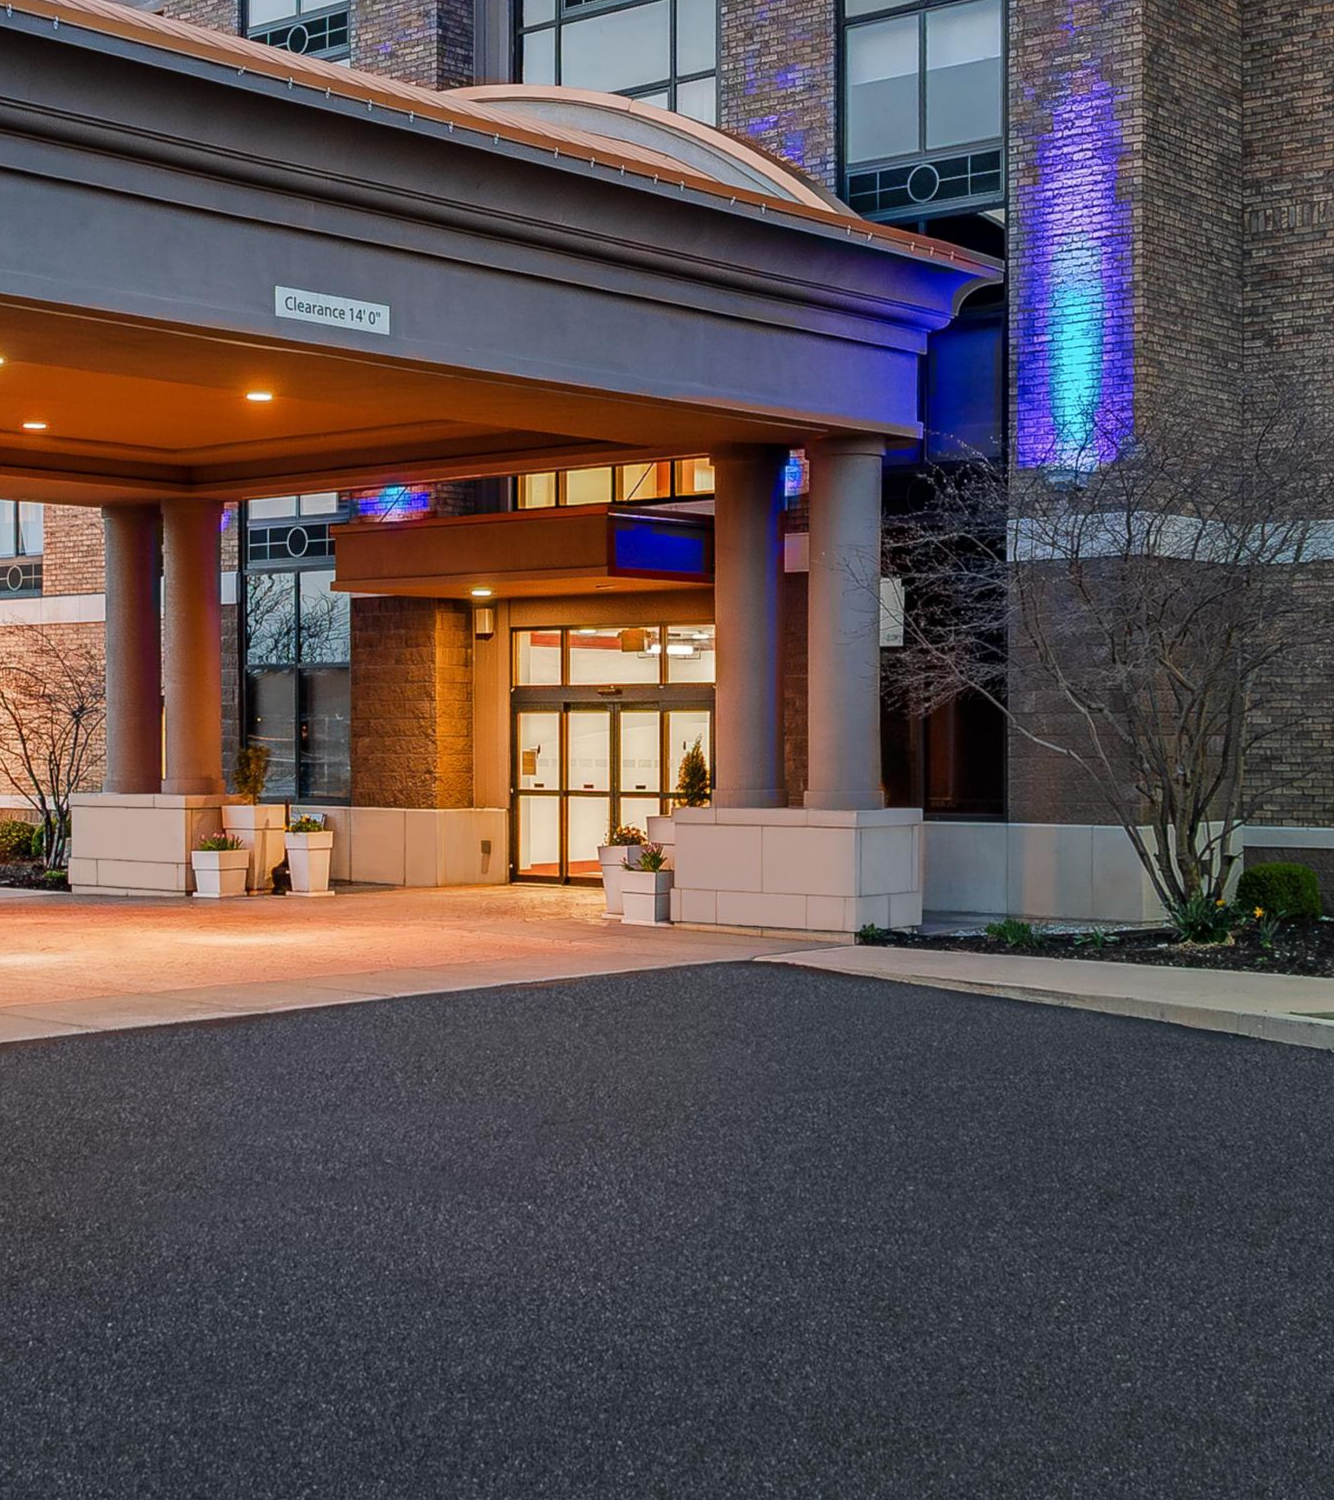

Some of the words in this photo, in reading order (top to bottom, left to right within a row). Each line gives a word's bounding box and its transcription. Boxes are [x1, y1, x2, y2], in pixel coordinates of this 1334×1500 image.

[284, 296, 346, 320] Clearance
[348, 307, 366, 323] 14'
[368, 311, 381, 325] 0"
